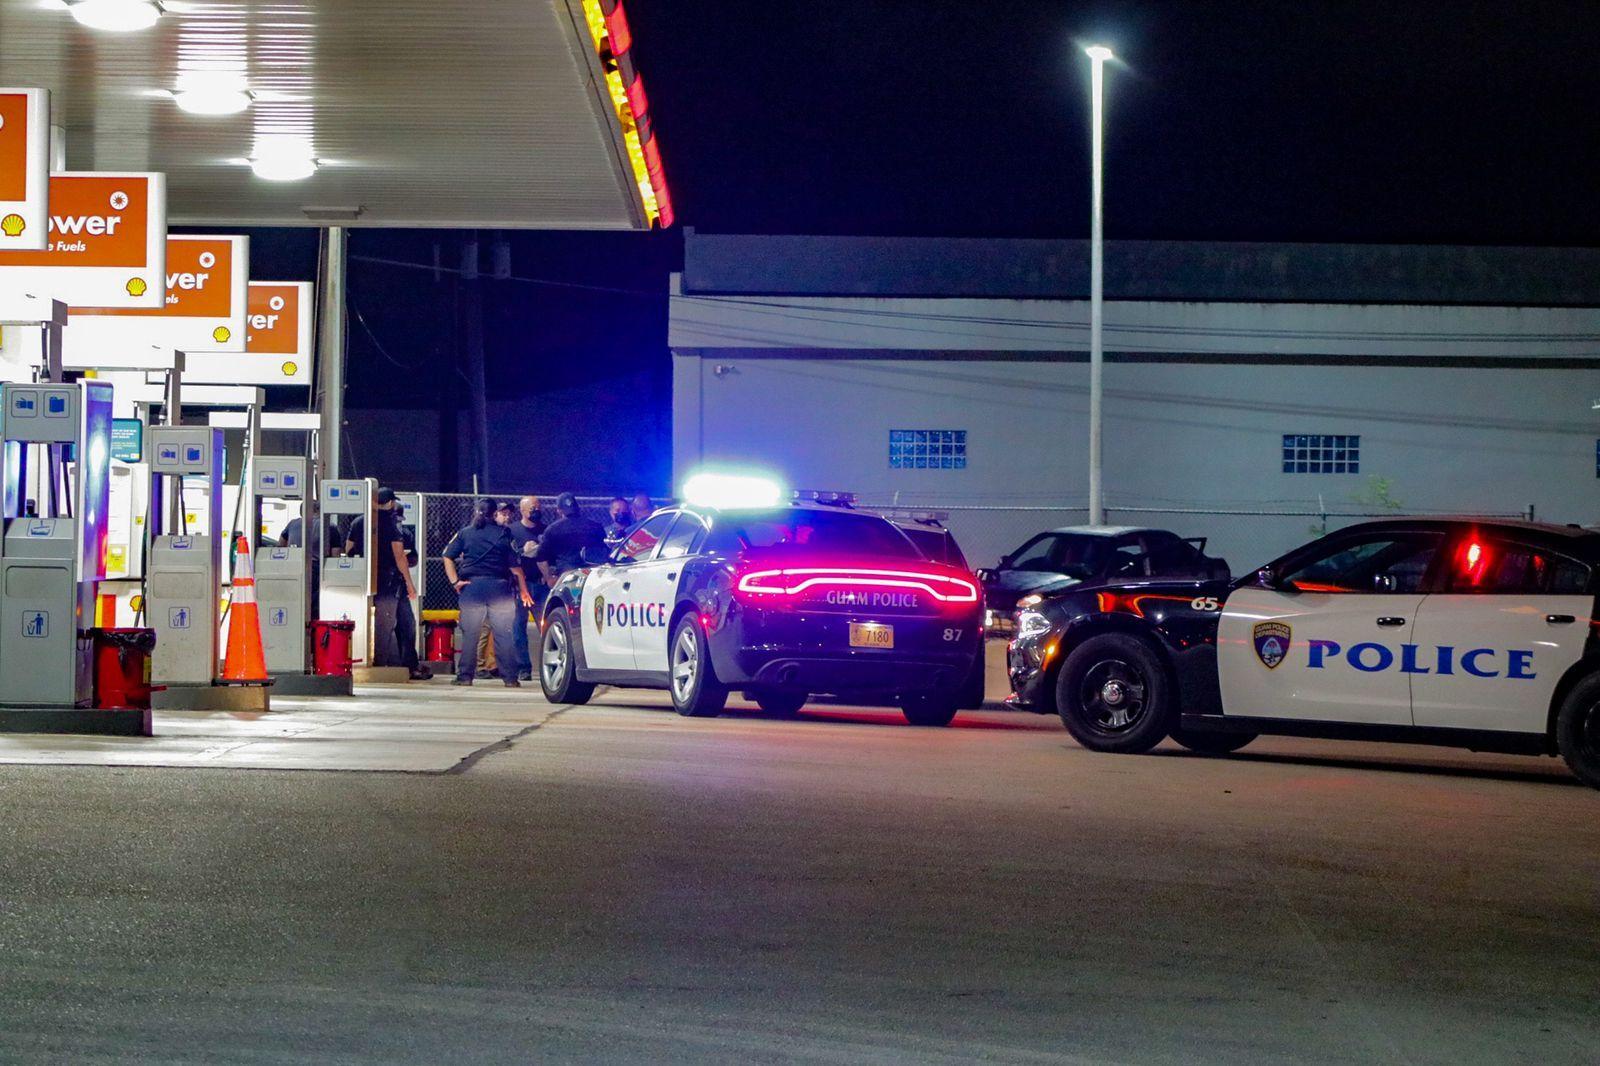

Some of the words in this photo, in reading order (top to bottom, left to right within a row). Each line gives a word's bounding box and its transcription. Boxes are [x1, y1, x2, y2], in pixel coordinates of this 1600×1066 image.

[48, 215, 121, 235] wer
[57, 240, 86, 252] Fuels
[826, 590, 869, 606] GUAM
[872, 592, 919, 608] POLICE
[1191, 596, 1218, 611] 65
[607, 602, 667, 628] POLICE
[865, 630, 889, 643] 7180
[942, 628, 963, 642] 87
[1306, 639, 1538, 680] POLICE
